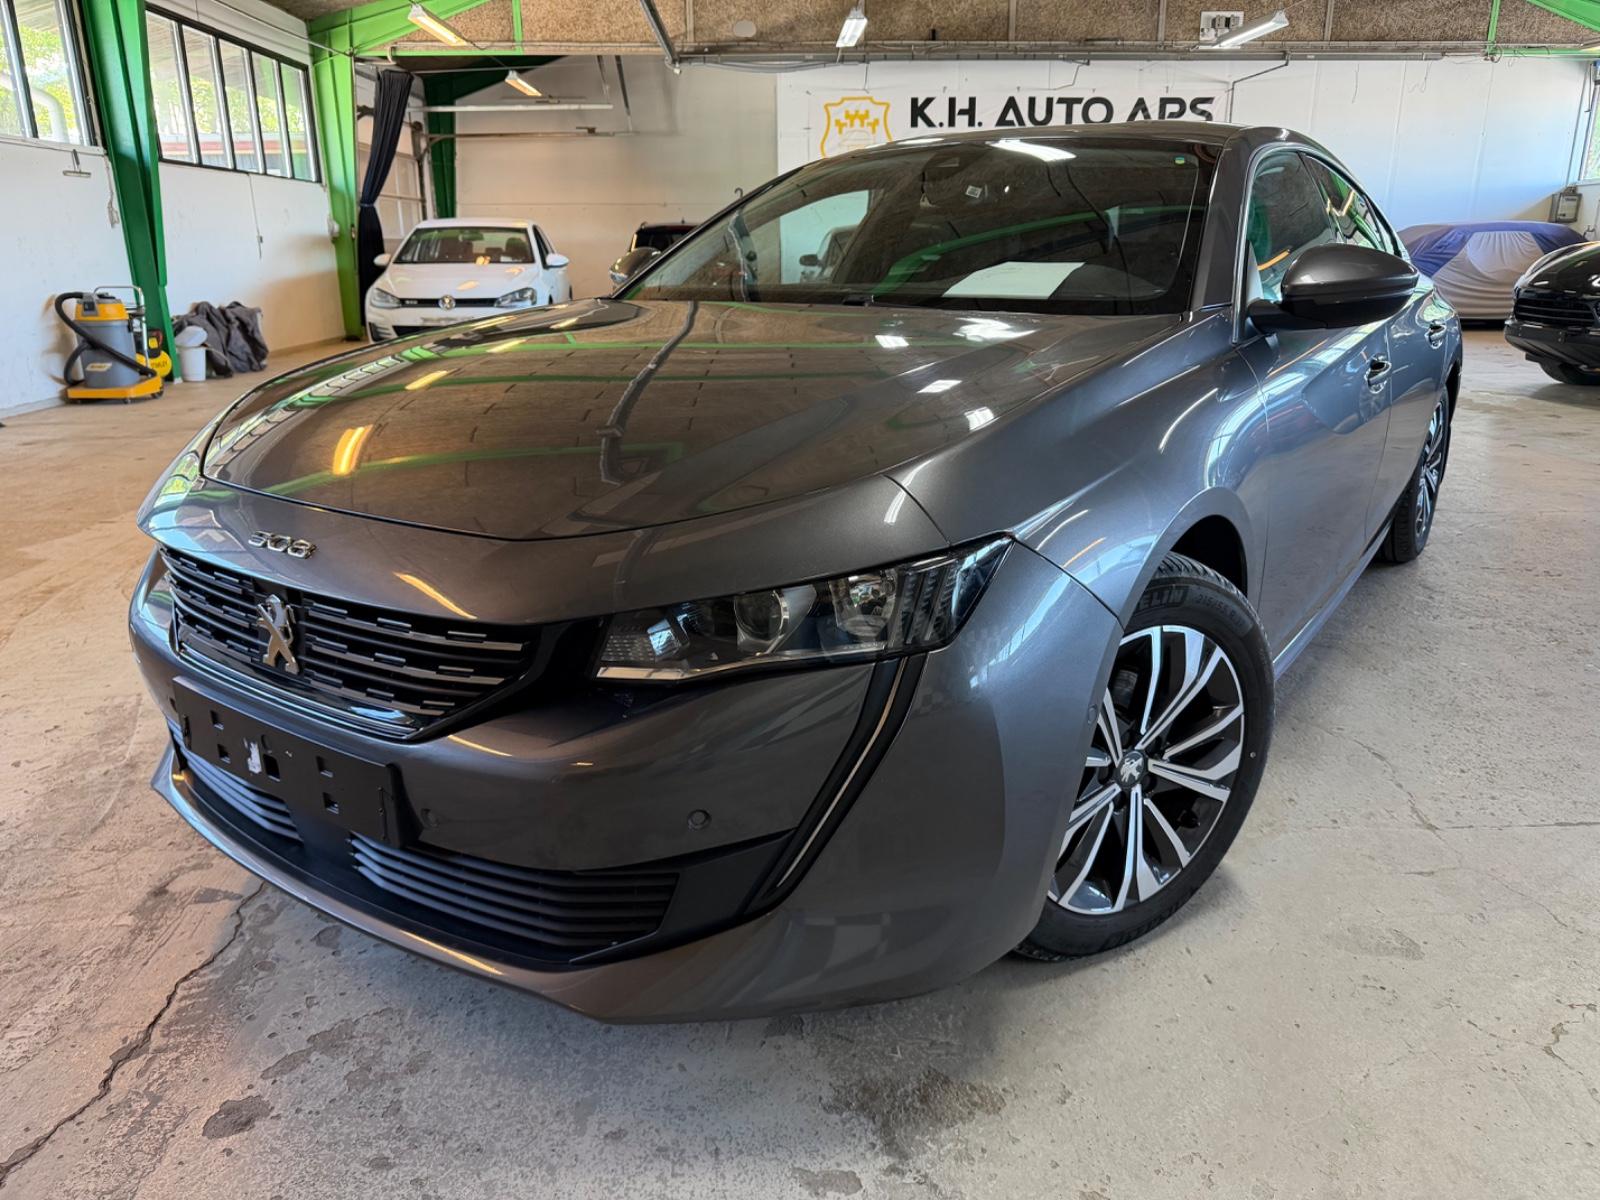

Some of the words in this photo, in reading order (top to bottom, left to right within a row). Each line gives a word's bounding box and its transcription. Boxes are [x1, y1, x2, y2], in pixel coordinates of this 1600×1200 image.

[910, 96, 983, 128] K.H.
[995, 96, 1114, 127] AUTO
[1126, 97, 1215, 122] APS
[248, 530, 315, 558] 508
[1139, 587, 1184, 609] ELIN
